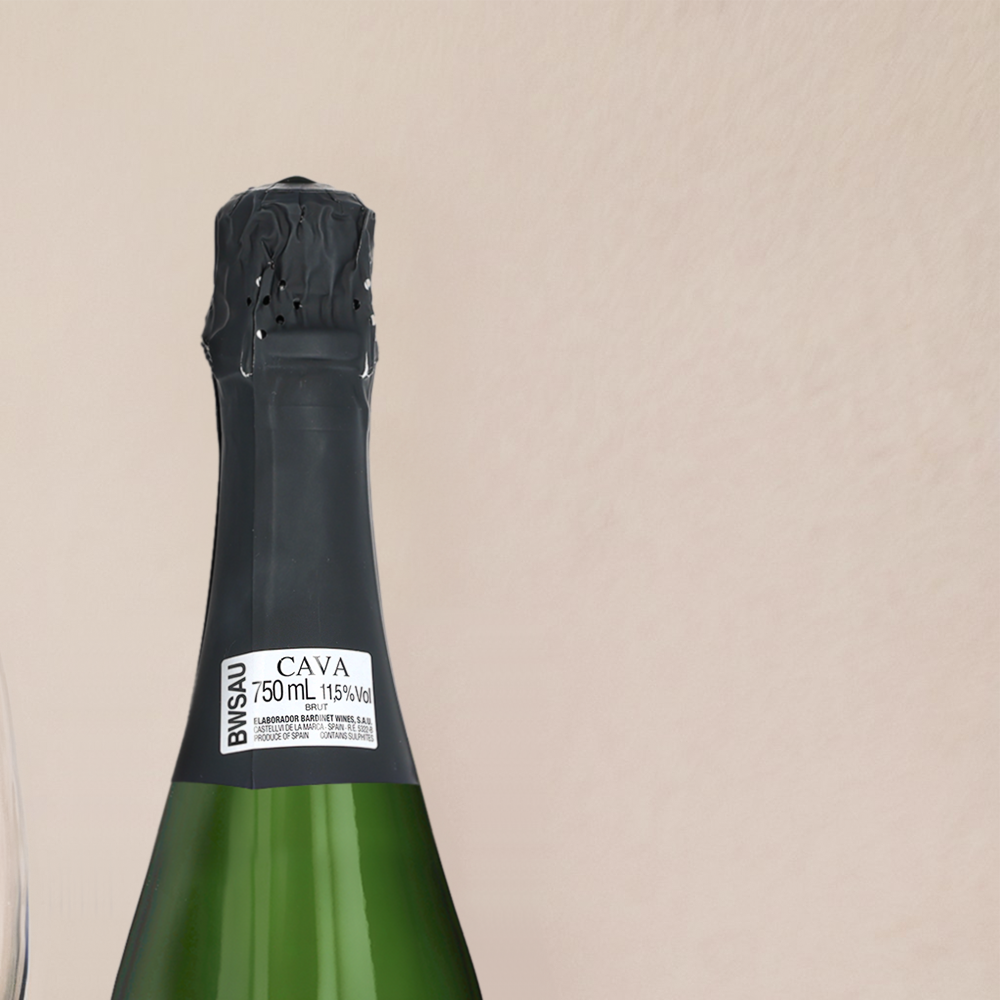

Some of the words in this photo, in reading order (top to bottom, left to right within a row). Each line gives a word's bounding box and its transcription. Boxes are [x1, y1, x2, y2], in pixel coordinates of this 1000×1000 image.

[276, 655, 350, 677] CAVA
[251, 679, 284, 703] 750
[287, 678, 316, 701] mL
[227, 662, 247, 747] BWSAU
[304, 703, 328, 711] BRUT
[253, 714, 299, 725] ELABORADOR
[300, 714, 334, 722] BARDINET
[285, 723, 293, 731] DE
[294, 723, 302, 731] LA
[302, 722, 324, 731] MARCA
[327, 722, 345, 731] SPAIN
[253, 732, 282, 742] PRODUCE
[282, 732, 291, 740] OF
[291, 731, 310, 740] SPAIN
[320, 731, 347, 740] CONTAINS
[347, 732, 375, 742] SULPHITES
